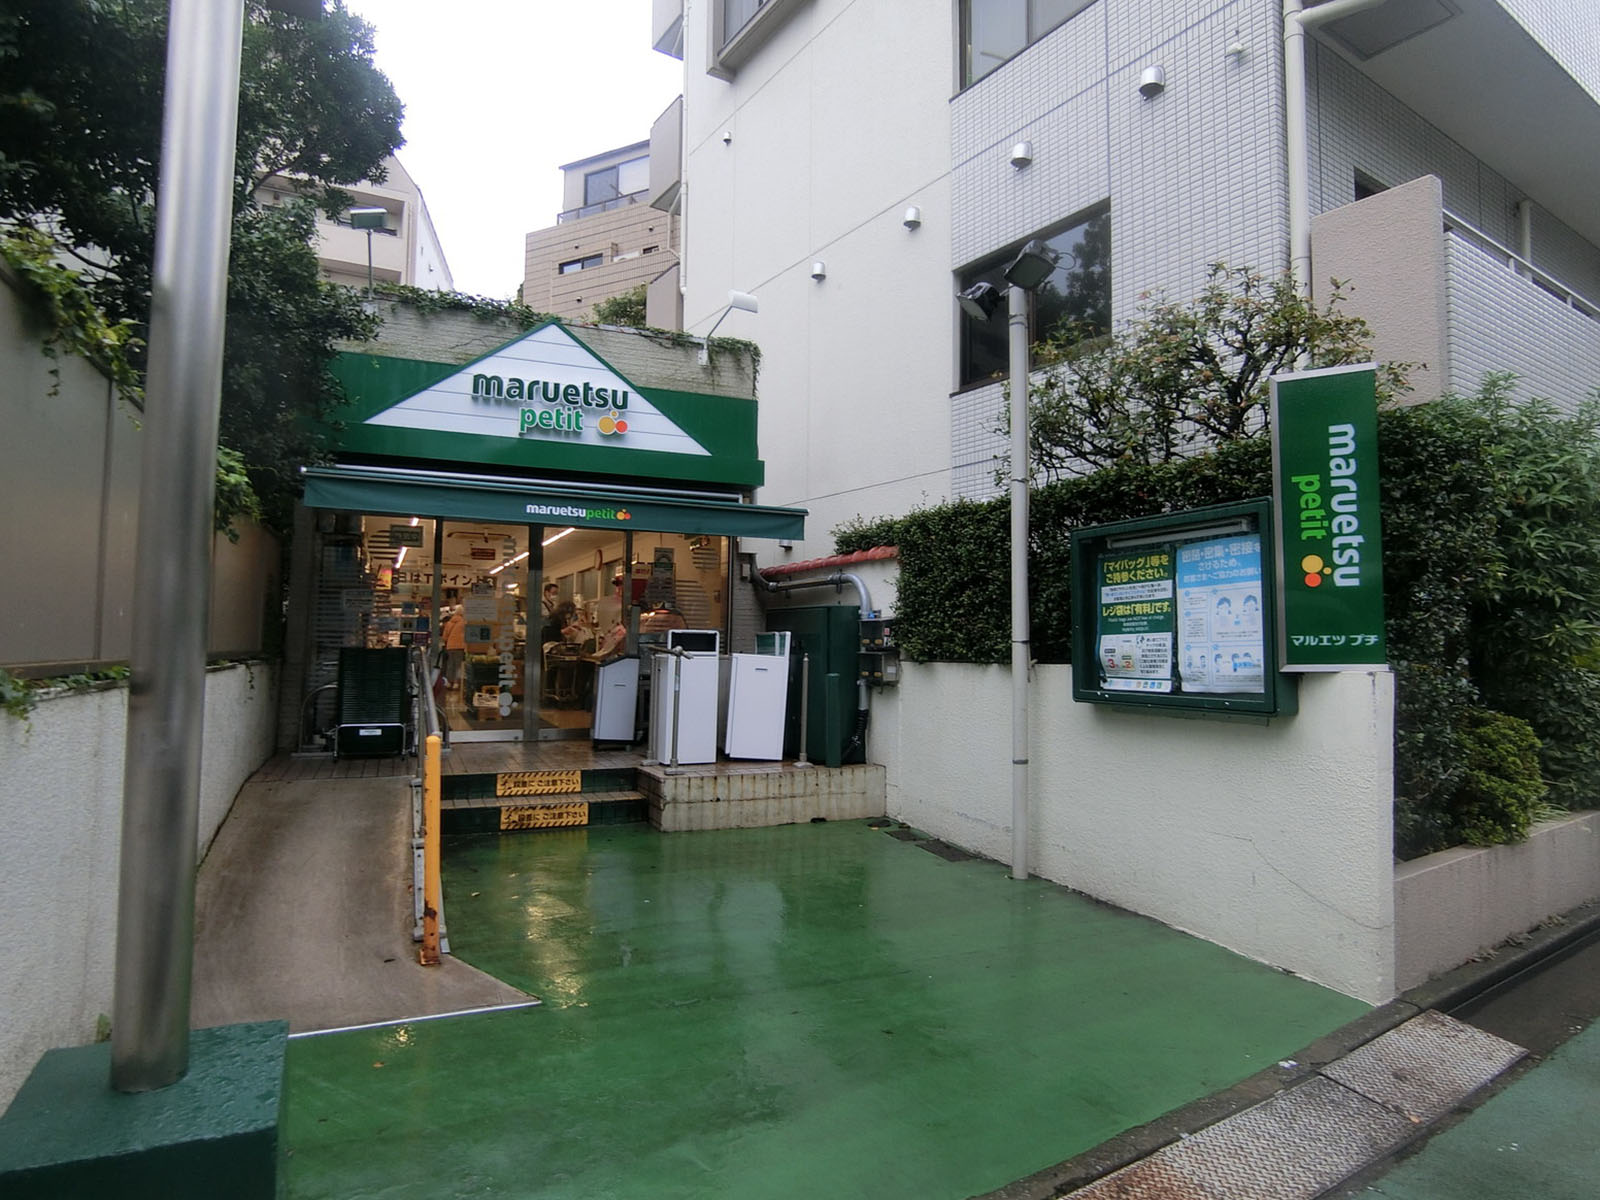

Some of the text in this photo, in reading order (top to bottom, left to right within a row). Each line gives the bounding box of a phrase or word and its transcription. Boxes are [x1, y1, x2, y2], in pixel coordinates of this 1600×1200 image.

[472, 373, 628, 410] maruetsu
[519, 407, 583, 432] petit
[1291, 474, 1329, 541] petit
[1328, 423, 1365, 587] maruetsu
[1290, 633, 1379, 647] マルエツ プチ
